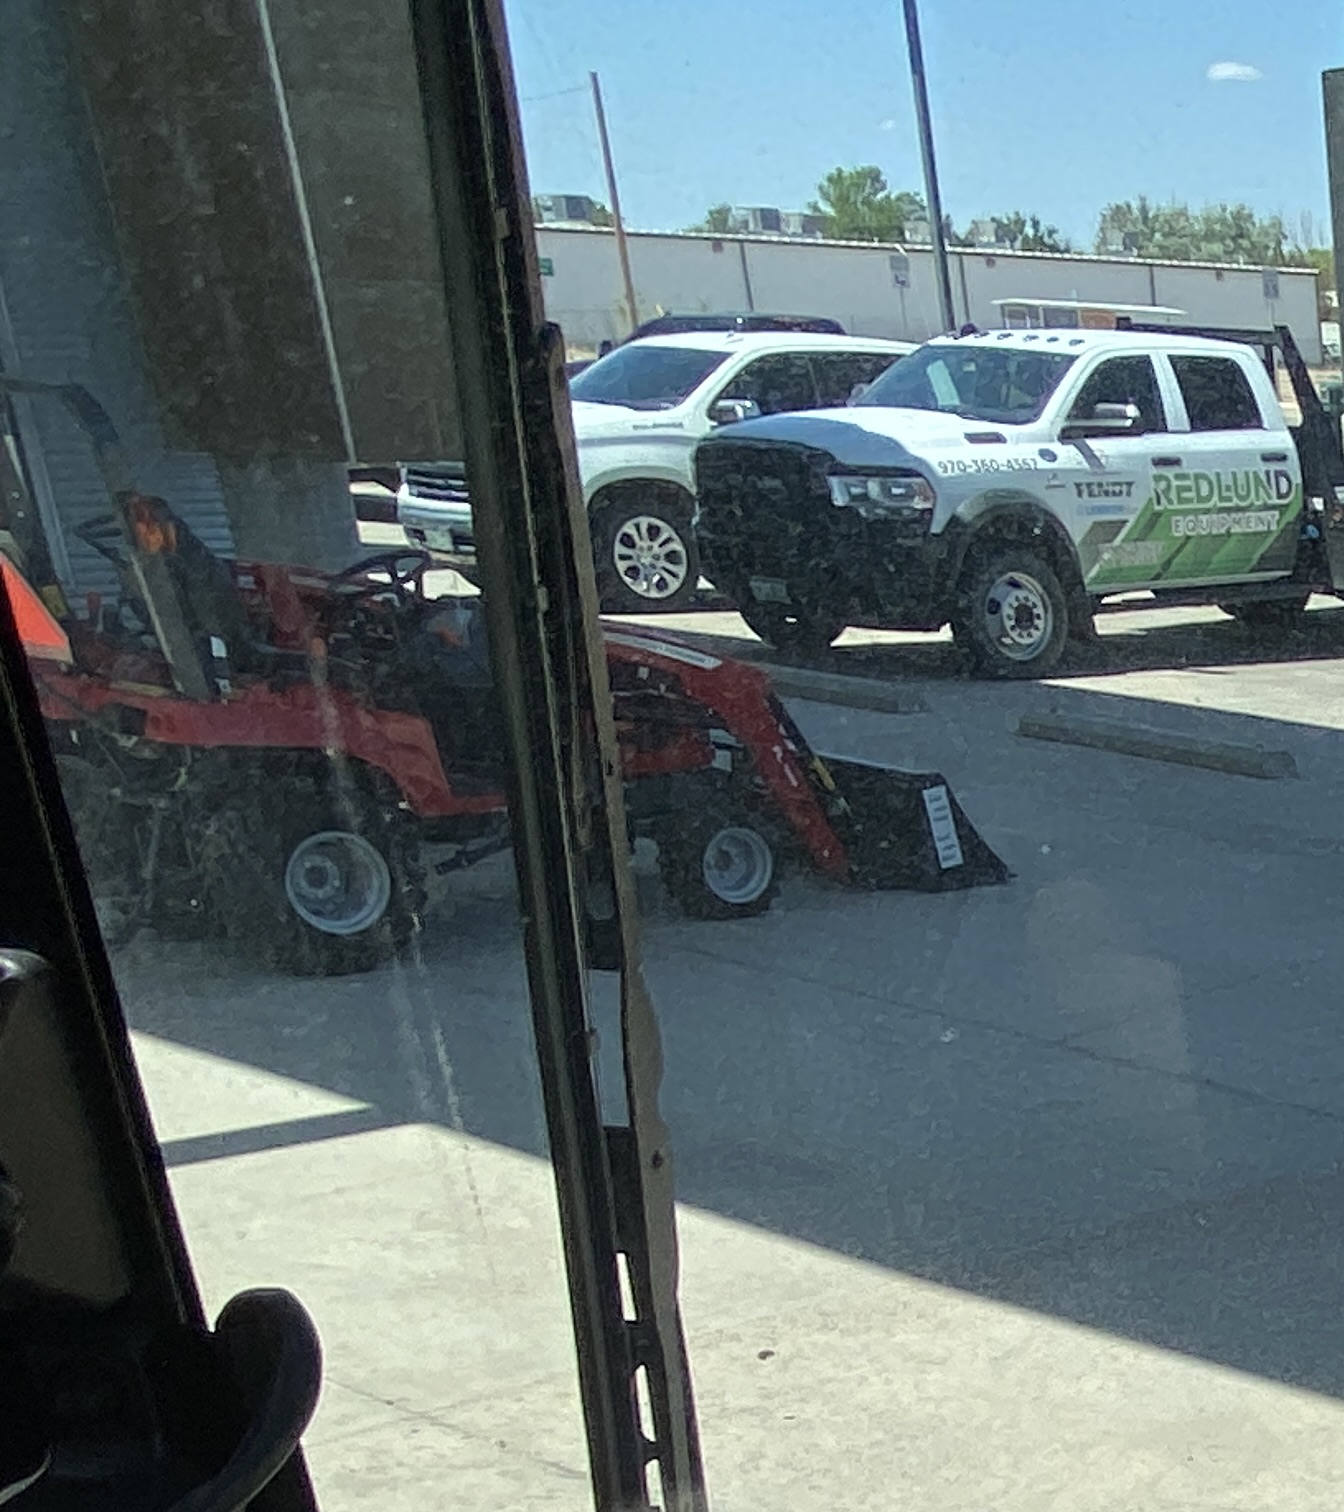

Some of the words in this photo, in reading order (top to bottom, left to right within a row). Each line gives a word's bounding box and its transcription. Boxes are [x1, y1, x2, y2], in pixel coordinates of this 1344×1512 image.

[1073, 480, 1135, 498] FENDT
[1151, 469, 1293, 507] REDLUND
[1172, 511, 1280, 536] EQUIPMENT
